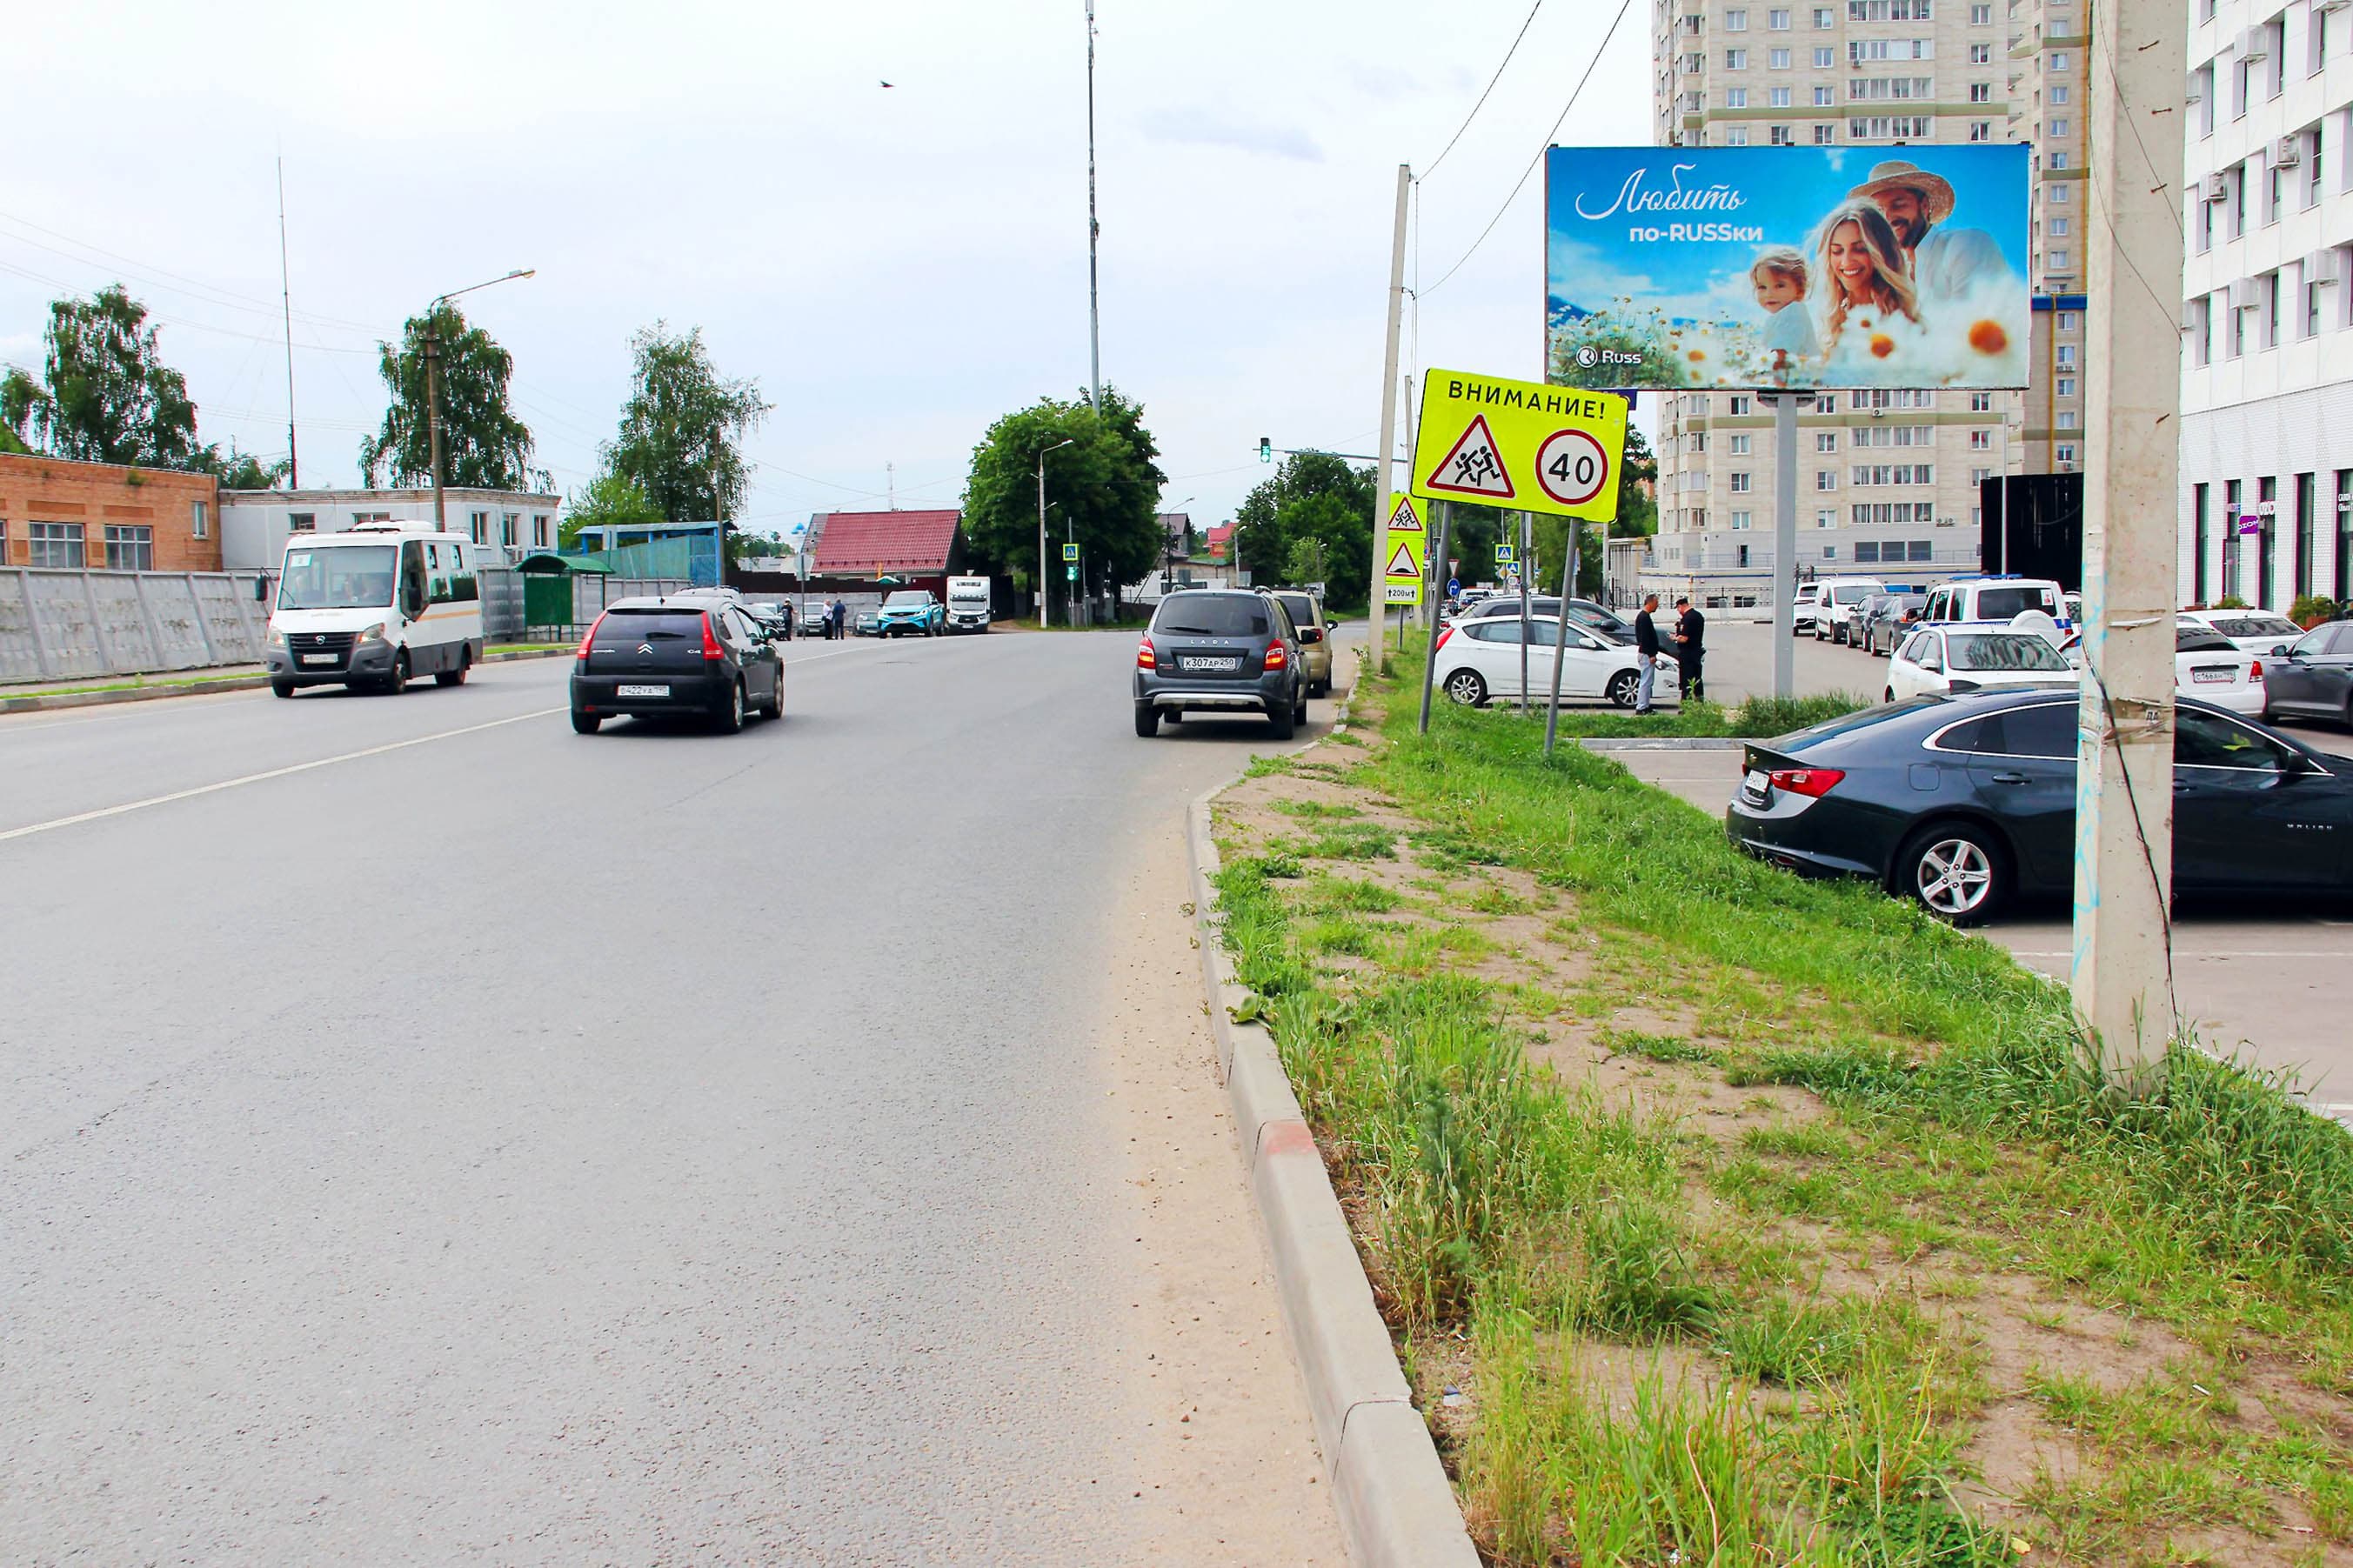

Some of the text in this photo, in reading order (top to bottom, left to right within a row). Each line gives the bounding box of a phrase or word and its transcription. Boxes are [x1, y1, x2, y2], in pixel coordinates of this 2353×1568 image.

[1575, 163, 1748, 220] Любить
[1629, 223, 1763, 243] по-RUSSки
[1448, 380, 1606, 419] ВНИМАНИЕ!
[1548, 453, 1594, 485] 40
